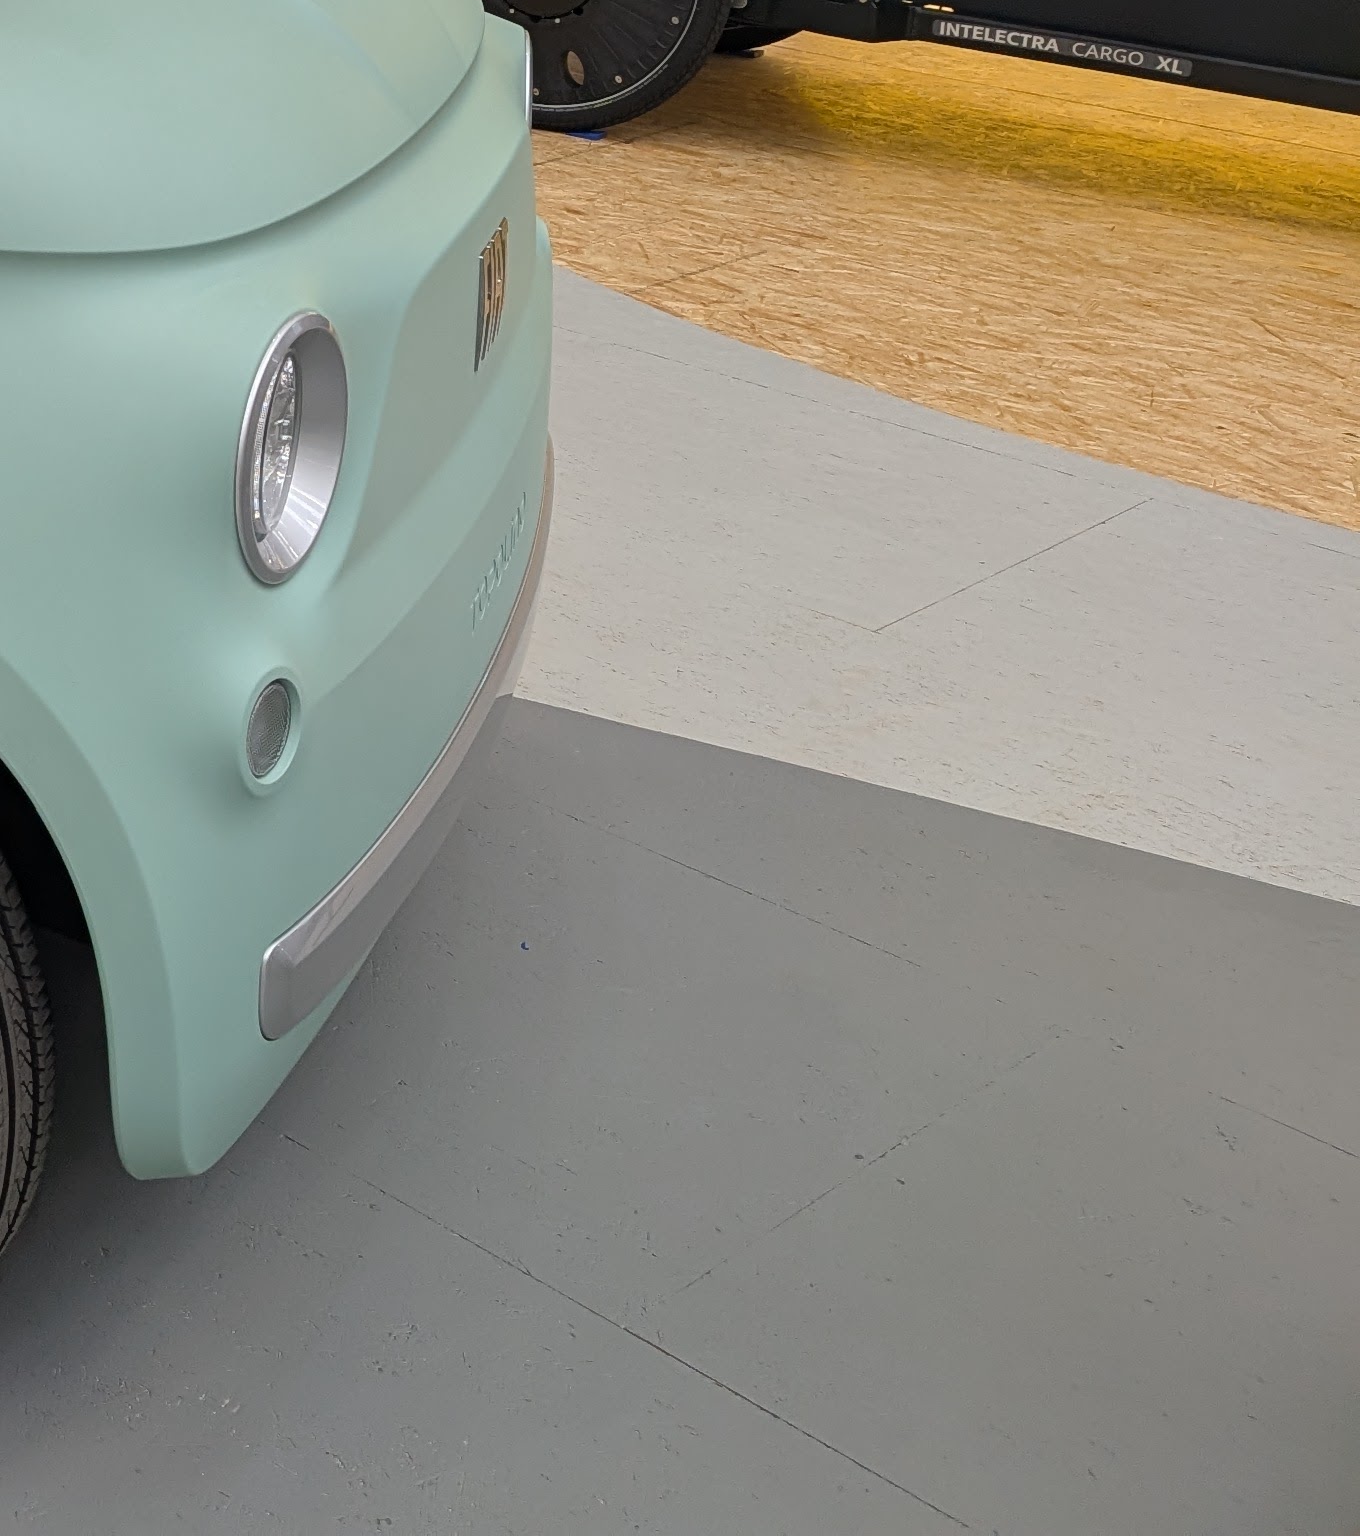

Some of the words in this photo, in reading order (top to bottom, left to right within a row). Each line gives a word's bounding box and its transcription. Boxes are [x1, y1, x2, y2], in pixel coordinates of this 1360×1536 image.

[939, 21, 1059, 53] INTELECTRA
[1072, 42, 1144, 66] CARGO
[1155, 55, 1183, 75] XL
